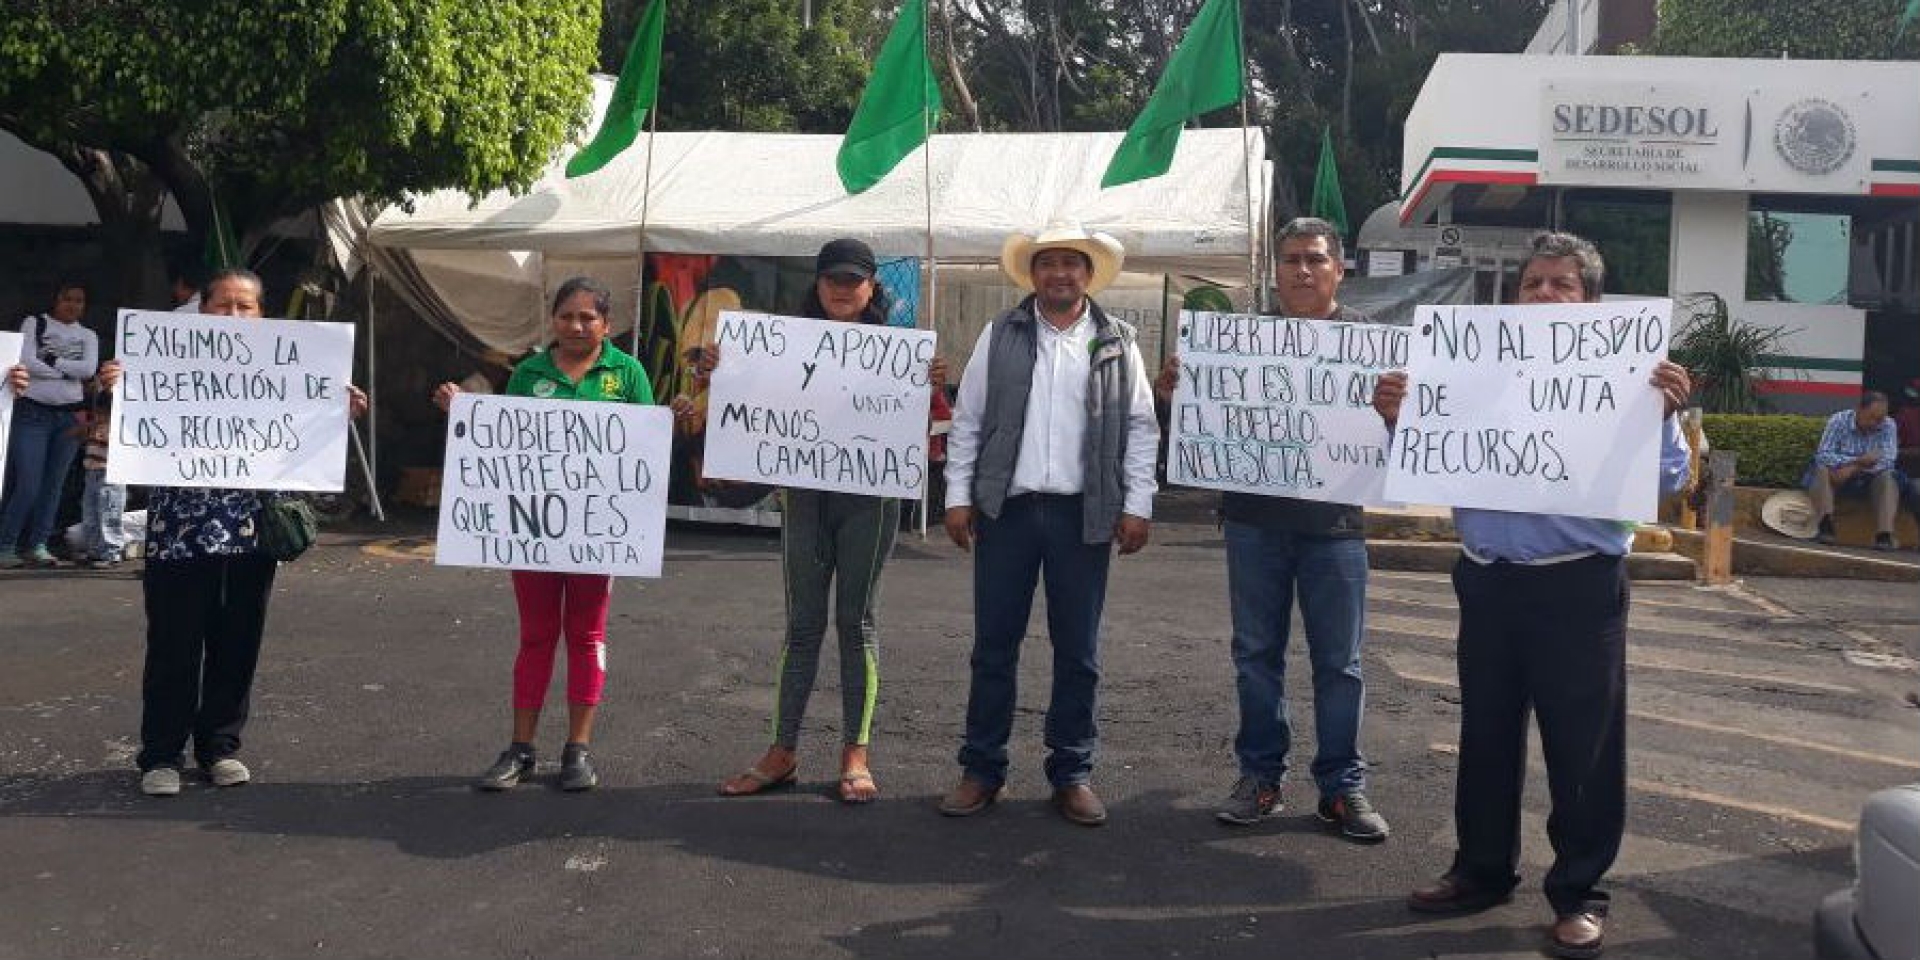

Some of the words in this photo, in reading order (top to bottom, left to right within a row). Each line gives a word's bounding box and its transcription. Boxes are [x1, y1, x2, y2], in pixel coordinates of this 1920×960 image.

[1552, 103, 1718, 138] SEDESOL
[1565, 159, 1652, 172] DESARROLLO
[122, 313, 252, 365] EXIGIMOS
[274, 335, 299, 366] LA
[1432, 308, 1481, 362] NO
[1499, 320, 1535, 363] AL
[814, 328, 932, 387] APOYOS
[121, 369, 287, 402] LIBERACIÓN
[305, 372, 331, 400] DE
[1207, 367, 1249, 402] LEY
[1261, 365, 1296, 404] ES
[1307, 367, 1338, 405] LO
[1347, 371, 1375, 408] QU
[1418, 383, 1450, 417] DE
[119, 414, 168, 449] LOS
[181, 413, 300, 451] RECURSOS
[470, 400, 626, 455] GOBIERNO
[720, 403, 820, 442] MENOS
[1180, 404, 1213, 437] EL
[459, 454, 605, 492] ENTREGA
[618, 456, 651, 493] LO
[756, 434, 923, 489] CAMPAÑAS
[1327, 443, 1385, 468] UNTA
[1399, 427, 1569, 482] RECURSOS.
[451, 497, 498, 533] QUE
[507, 494, 568, 539] NO
[583, 495, 628, 538] ES
[474, 535, 549, 566] TUYO
[569, 542, 640, 564] UNTA
